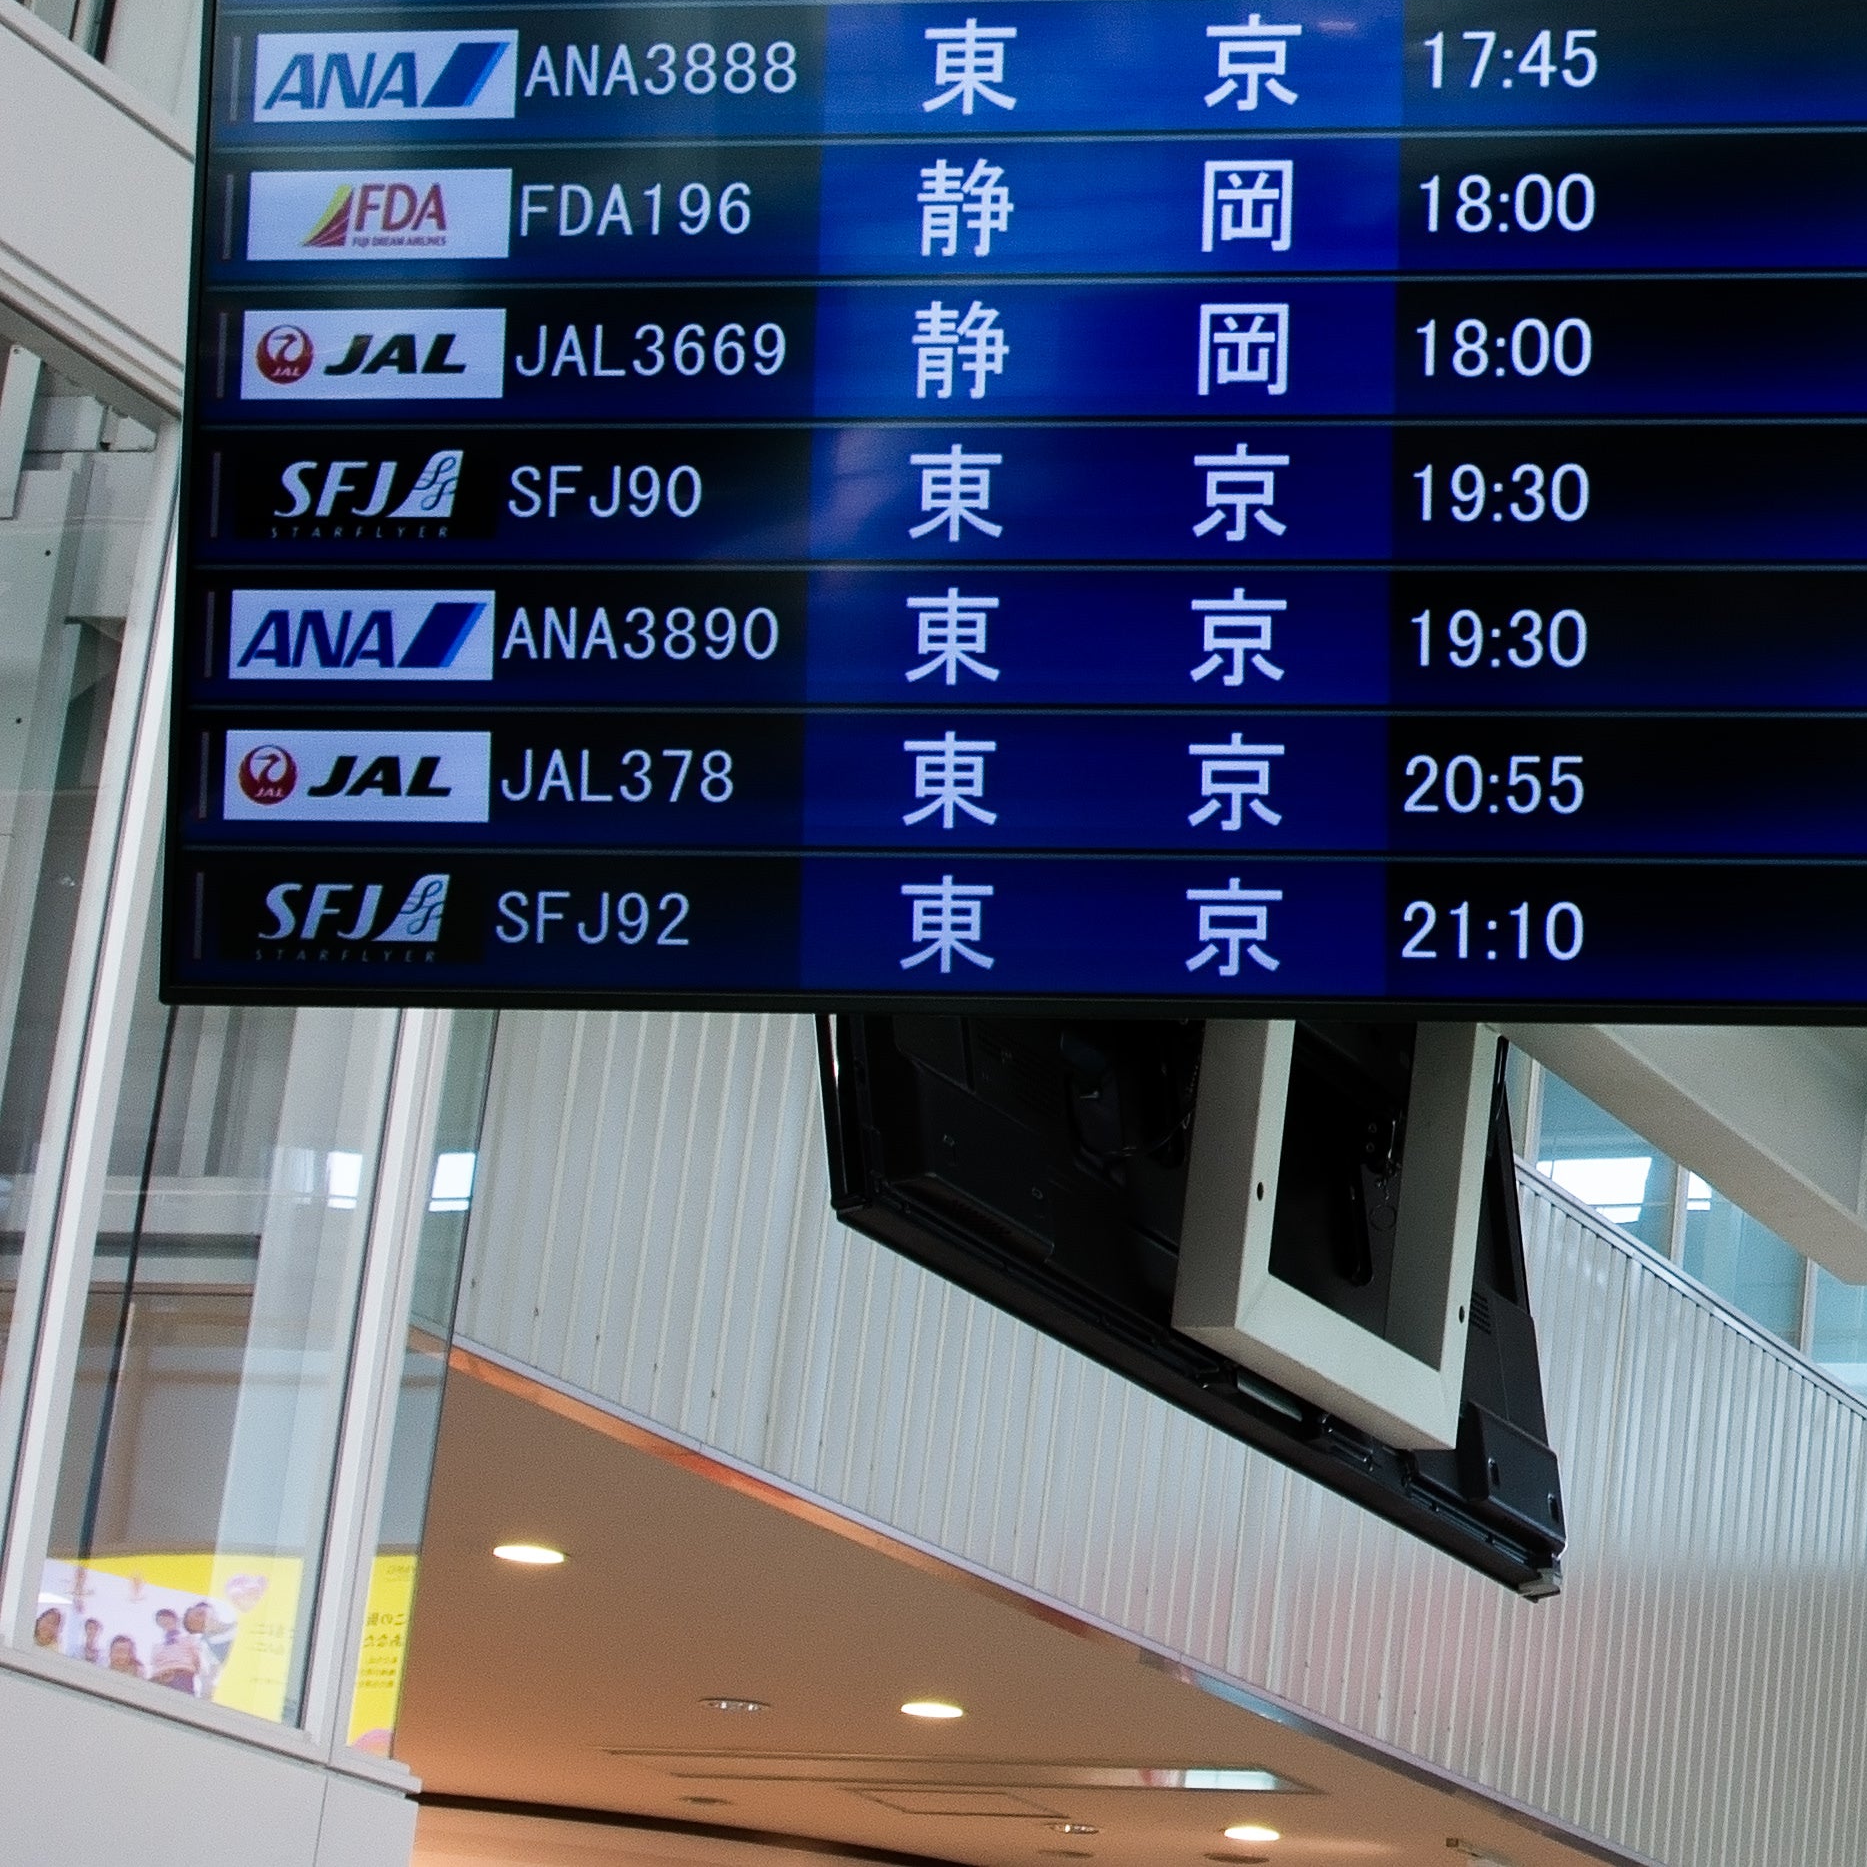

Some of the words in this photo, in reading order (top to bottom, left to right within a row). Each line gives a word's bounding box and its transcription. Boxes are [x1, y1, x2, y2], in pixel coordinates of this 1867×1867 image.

[262, 51, 421, 111] ANA
[524, 41, 797, 97] ANA3888
[922, 13, 1302, 115] 東京
[1424, 29, 1597, 89] 17:45
[355, 183, 446, 231] FDA
[521, 182, 751, 236] FDA196
[917, 158, 1293, 257] 静岡
[1420, 173, 1595, 232] 18:00
[271, 368, 300, 380] JAL
[323, 333, 466, 375] JAL
[516, 323, 786, 377] JAL3669
[911, 300, 1289, 399] 静岡
[1417, 318, 1592, 377] 18:00
[270, 526, 448, 538] STARFLYER
[273, 461, 398, 518] SFJ
[508, 465, 702, 518] SFJ90
[909, 443, 1290, 542] 東京
[1414, 463, 1589, 522] 19:30
[236, 609, 395, 668] ANA
[502, 607, 779, 660] ANA3890
[905, 587, 1287, 686] 東京
[1412, 609, 1587, 668] 19:30
[254, 788, 285, 800] JAL
[307, 755, 452, 798] JAL
[501, 748, 733, 803] JAL378
[902, 731, 1285, 831] 東京
[1404, 755, 1584, 814] 20:55
[255, 950, 436, 963] STARFLYER
[258, 883, 382, 941] SFJ
[496, 891, 689, 946] SFJ92
[900, 875, 1283, 976] 東京
[1402, 900, 1584, 960] 21:10
